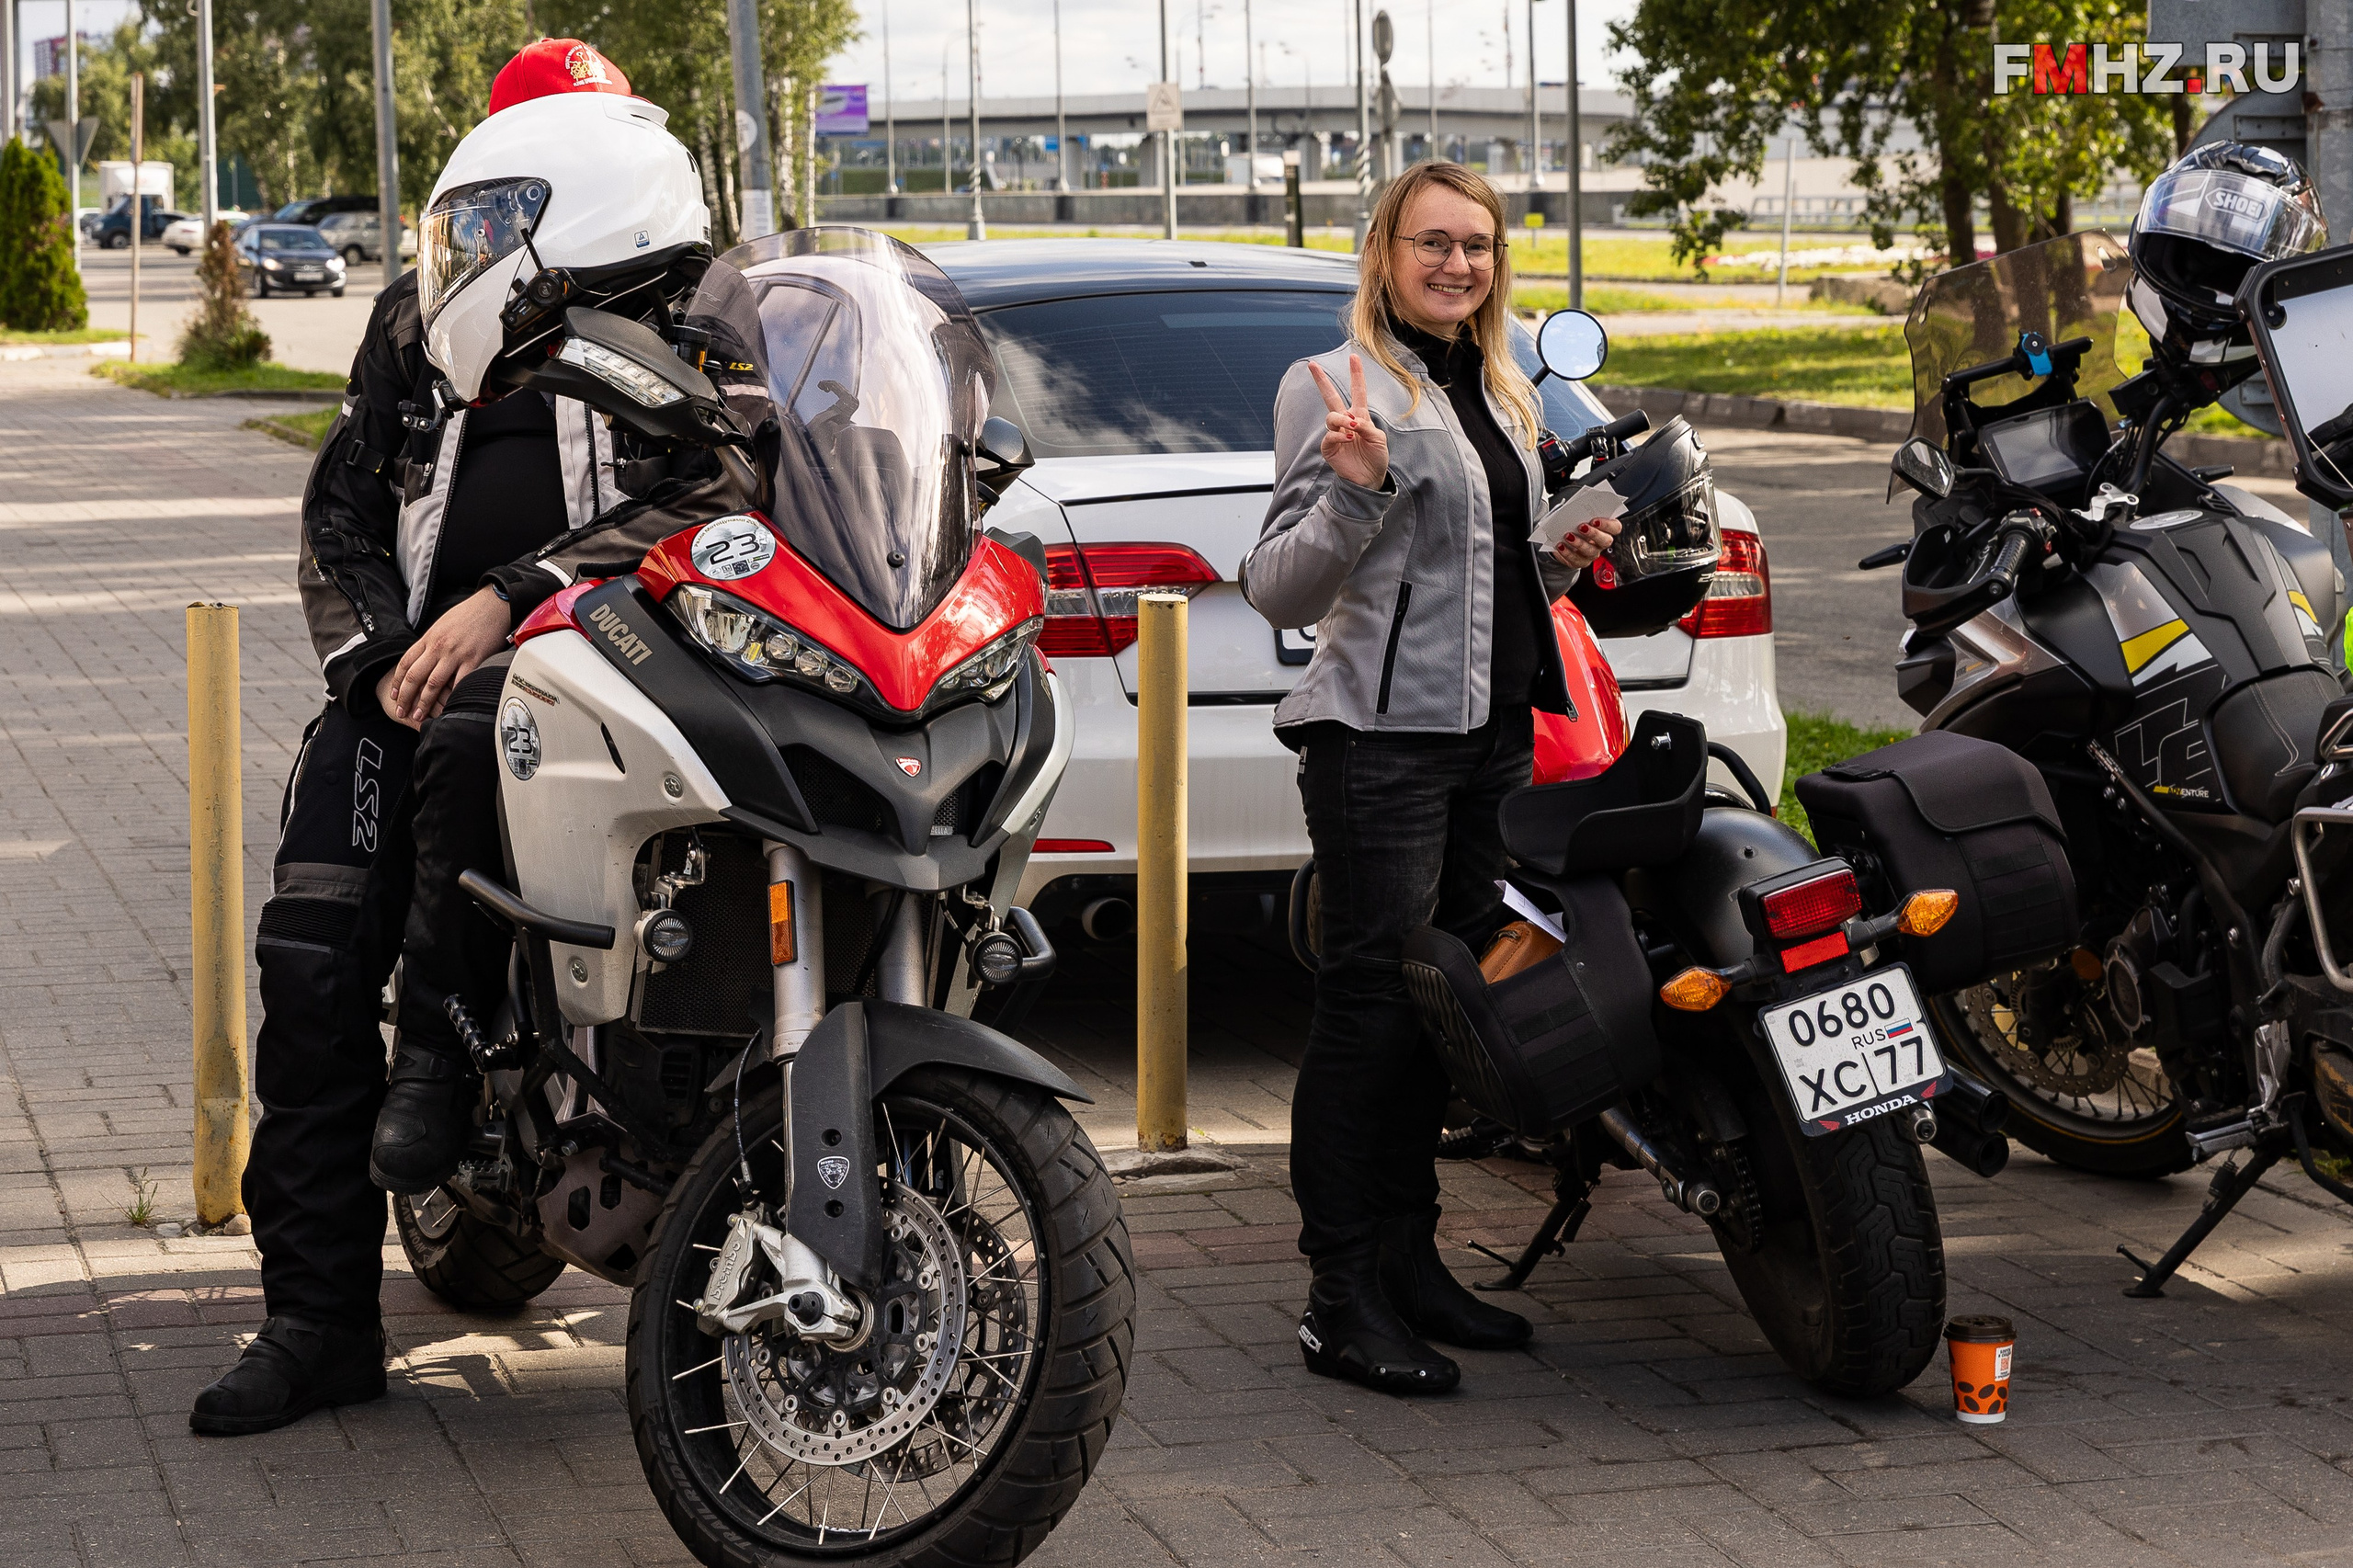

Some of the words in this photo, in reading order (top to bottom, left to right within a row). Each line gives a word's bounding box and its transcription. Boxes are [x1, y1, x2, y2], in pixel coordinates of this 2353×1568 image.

[2213, 191, 2264, 219] SHOEI
[729, 362, 754, 370] LS2
[705, 533, 760, 565] 23
[589, 603, 654, 666] DUCATI
[507, 726, 532, 754] 23
[352, 737, 383, 852] LS2
[1788, 983, 1895, 1047] 0680
[1851, 1028, 1886, 1050] RUS
[1874, 1035, 1924, 1085] 77
[1845, 1095, 1918, 1126] HONDA
[407, 1227, 429, 1254] AVON
[710, 1242, 741, 1301] brembo
[656, 1430, 752, 1551] TRAILRIDER
